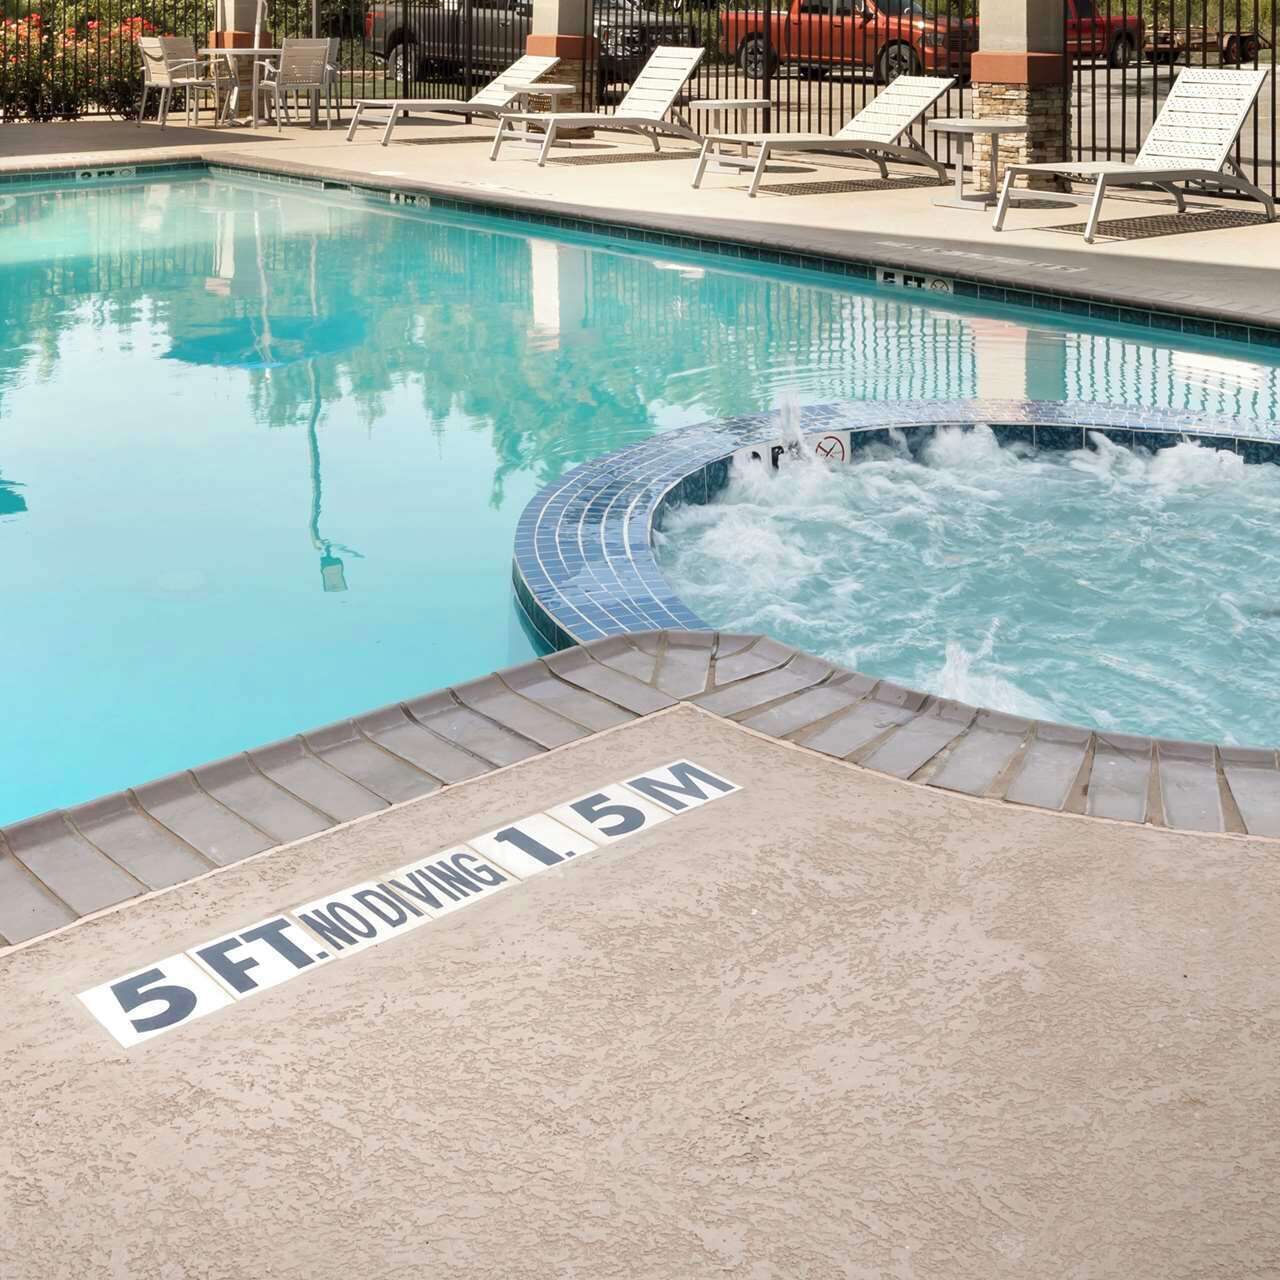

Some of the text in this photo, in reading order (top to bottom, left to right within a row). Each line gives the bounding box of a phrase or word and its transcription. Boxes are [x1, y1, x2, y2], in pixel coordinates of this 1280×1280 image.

[110, 968, 198, 1033] 5
[195, 918, 330, 992] FT.
[298, 902, 378, 951] NO
[351, 853, 508, 928] DIVING
[627, 761, 737, 812] M
